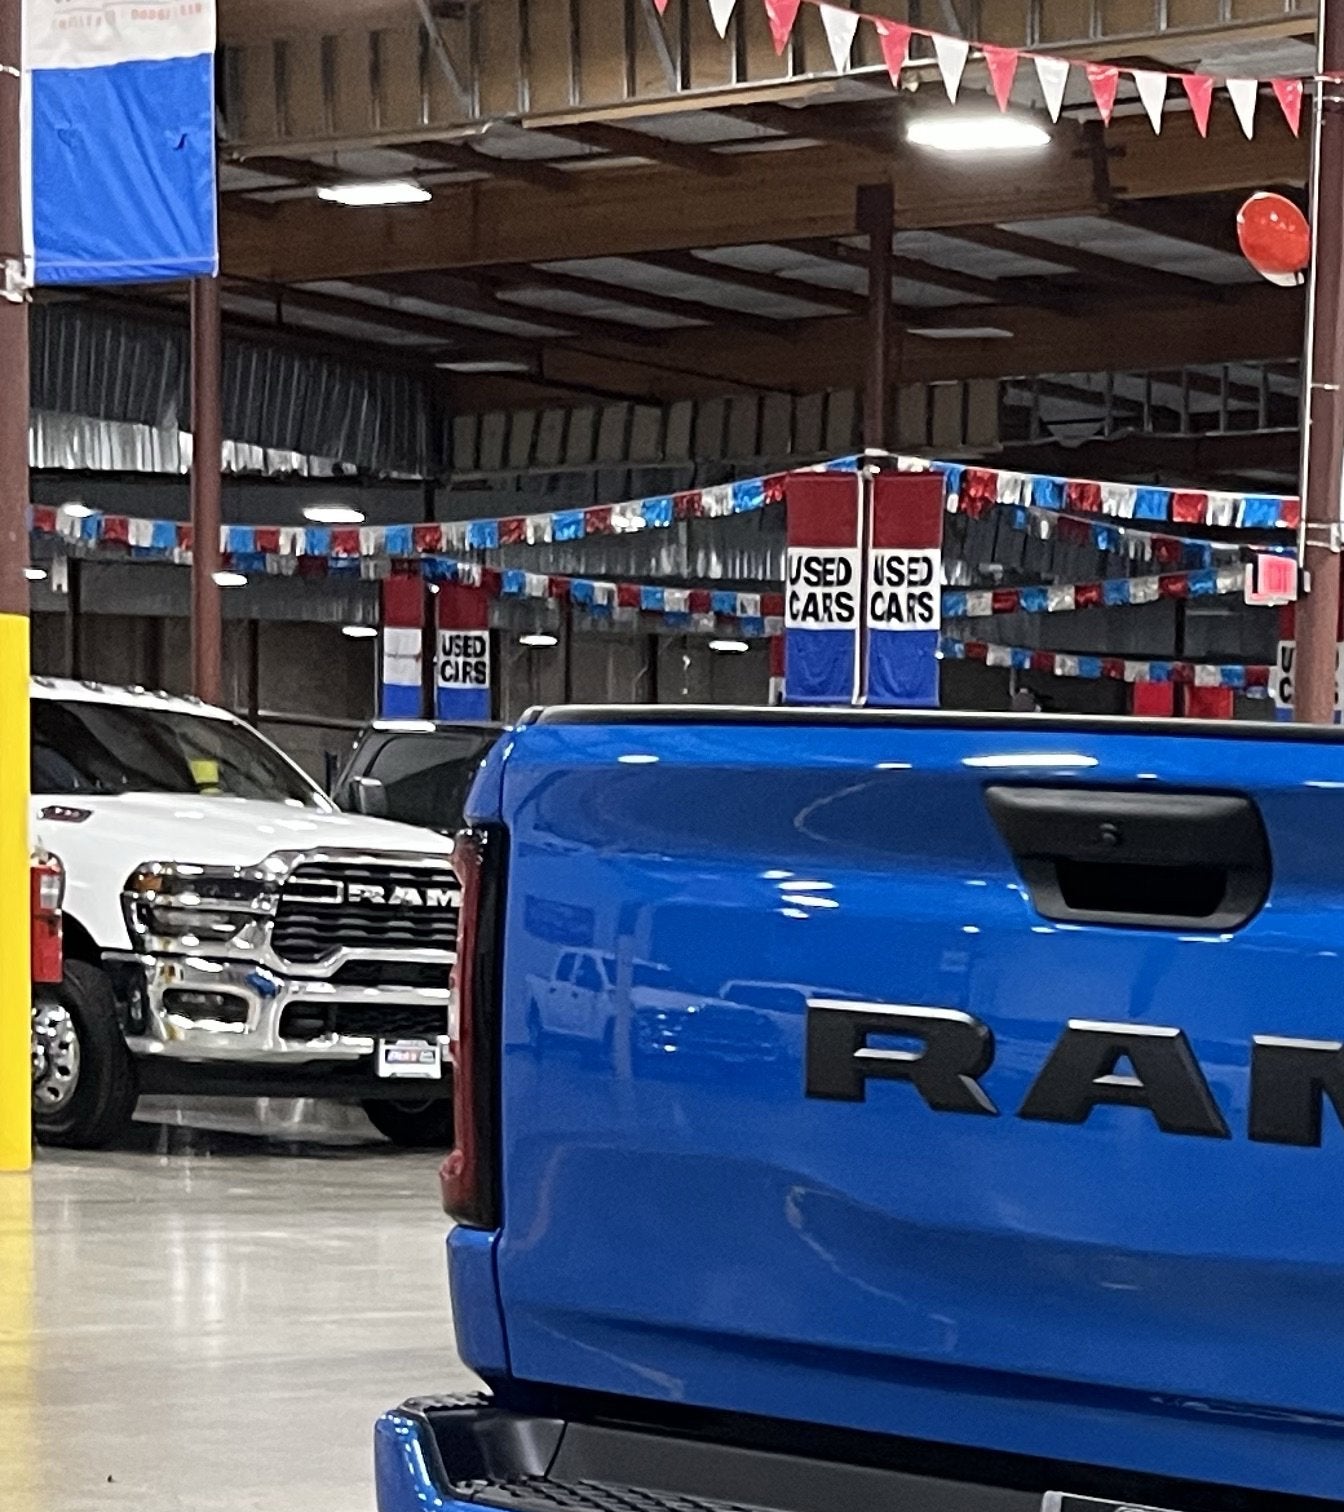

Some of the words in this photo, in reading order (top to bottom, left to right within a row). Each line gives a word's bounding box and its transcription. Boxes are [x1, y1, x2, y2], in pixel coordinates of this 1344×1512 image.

[788, 555, 852, 587] USED
[873, 555, 933, 587] USED
[789, 590, 855, 622] CARS
[870, 591, 934, 623] CARS
[441, 634, 486, 658] USED
[348, 883, 463, 908] RAM
